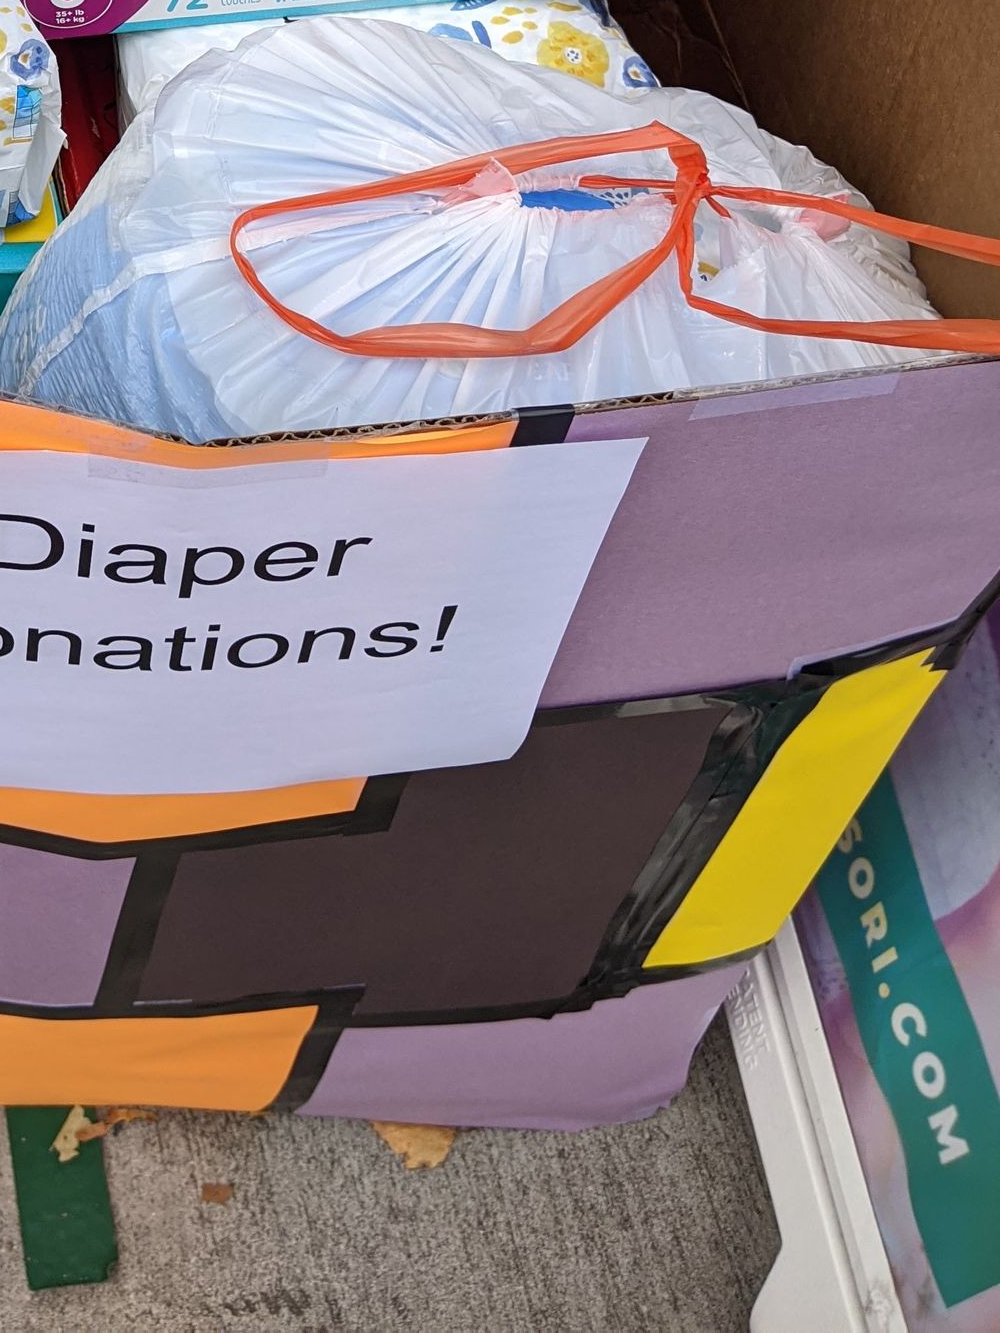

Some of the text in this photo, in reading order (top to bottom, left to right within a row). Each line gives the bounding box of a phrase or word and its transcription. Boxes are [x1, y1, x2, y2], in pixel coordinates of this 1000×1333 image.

[55, 9, 84, 18] 35+ lb
[55, 16, 85, 25] 16+ kg
[726, 970, 770, 1070] ATENT ENDING
